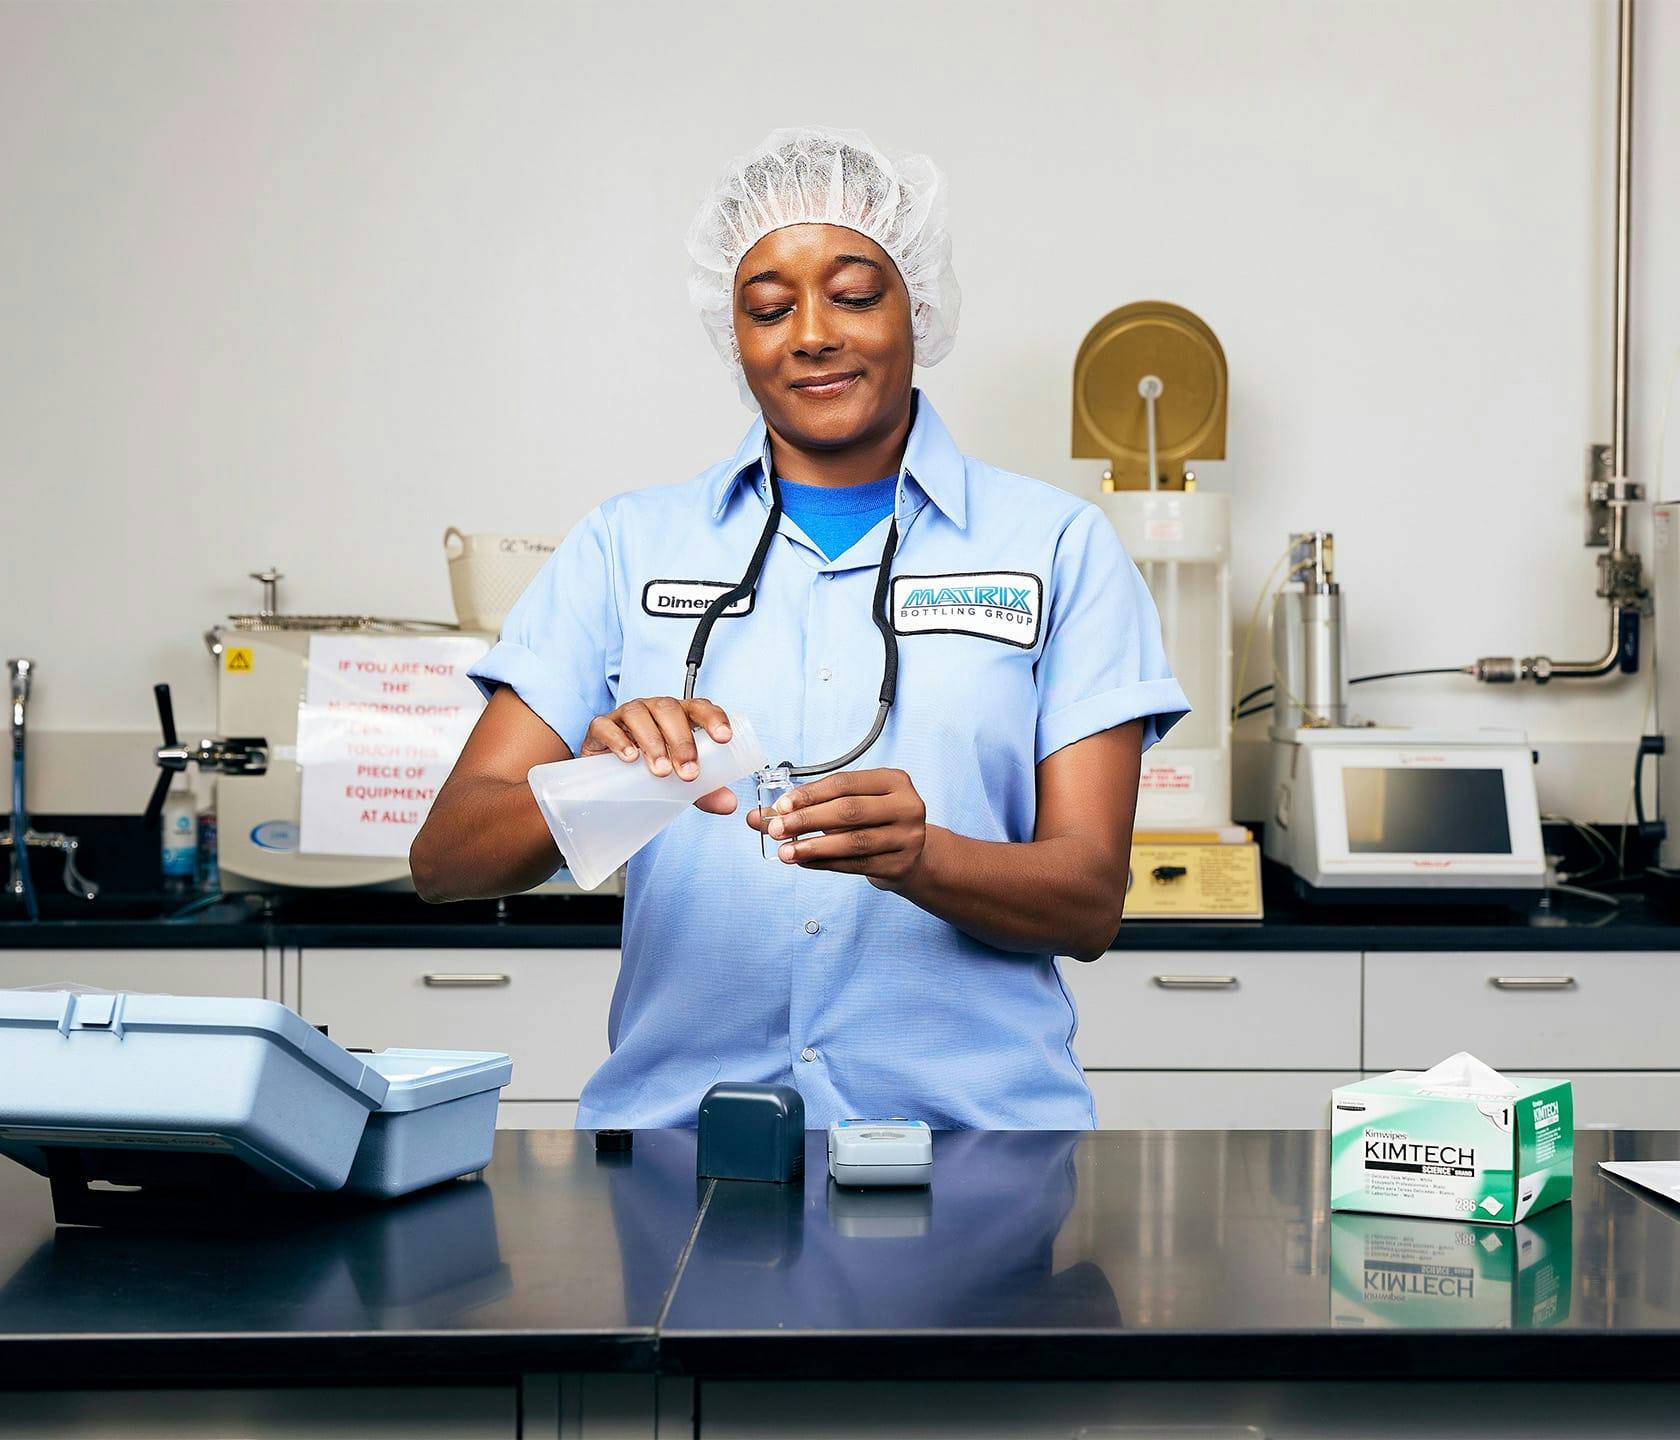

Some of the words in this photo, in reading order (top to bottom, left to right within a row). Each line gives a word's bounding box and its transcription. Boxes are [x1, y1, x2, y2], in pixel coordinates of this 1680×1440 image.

[902, 586, 1033, 616] MATRIX
[900, 608, 976, 618] BOTTLING
[985, 609, 1033, 626] GROUP
[338, 660, 352, 671] IF
[356, 661, 387, 673] YOU
[391, 663, 420, 675] ARE
[424, 664, 456, 676] NOT
[381, 682, 410, 693] THE
[357, 764, 400, 778] PIECE
[405, 766, 426, 779] OF
[345, 784, 435, 800] EQUIPMENT
[360, 810, 378, 823] AT
[1502, 1108, 1509, 1125] 1
[1365, 1129, 1408, 1141] Kimwipes
[1365, 1140, 1475, 1166] KIMTECH
[1422, 1165, 1452, 1176] SCIENCE
[1456, 1199, 1476, 1212] 286
